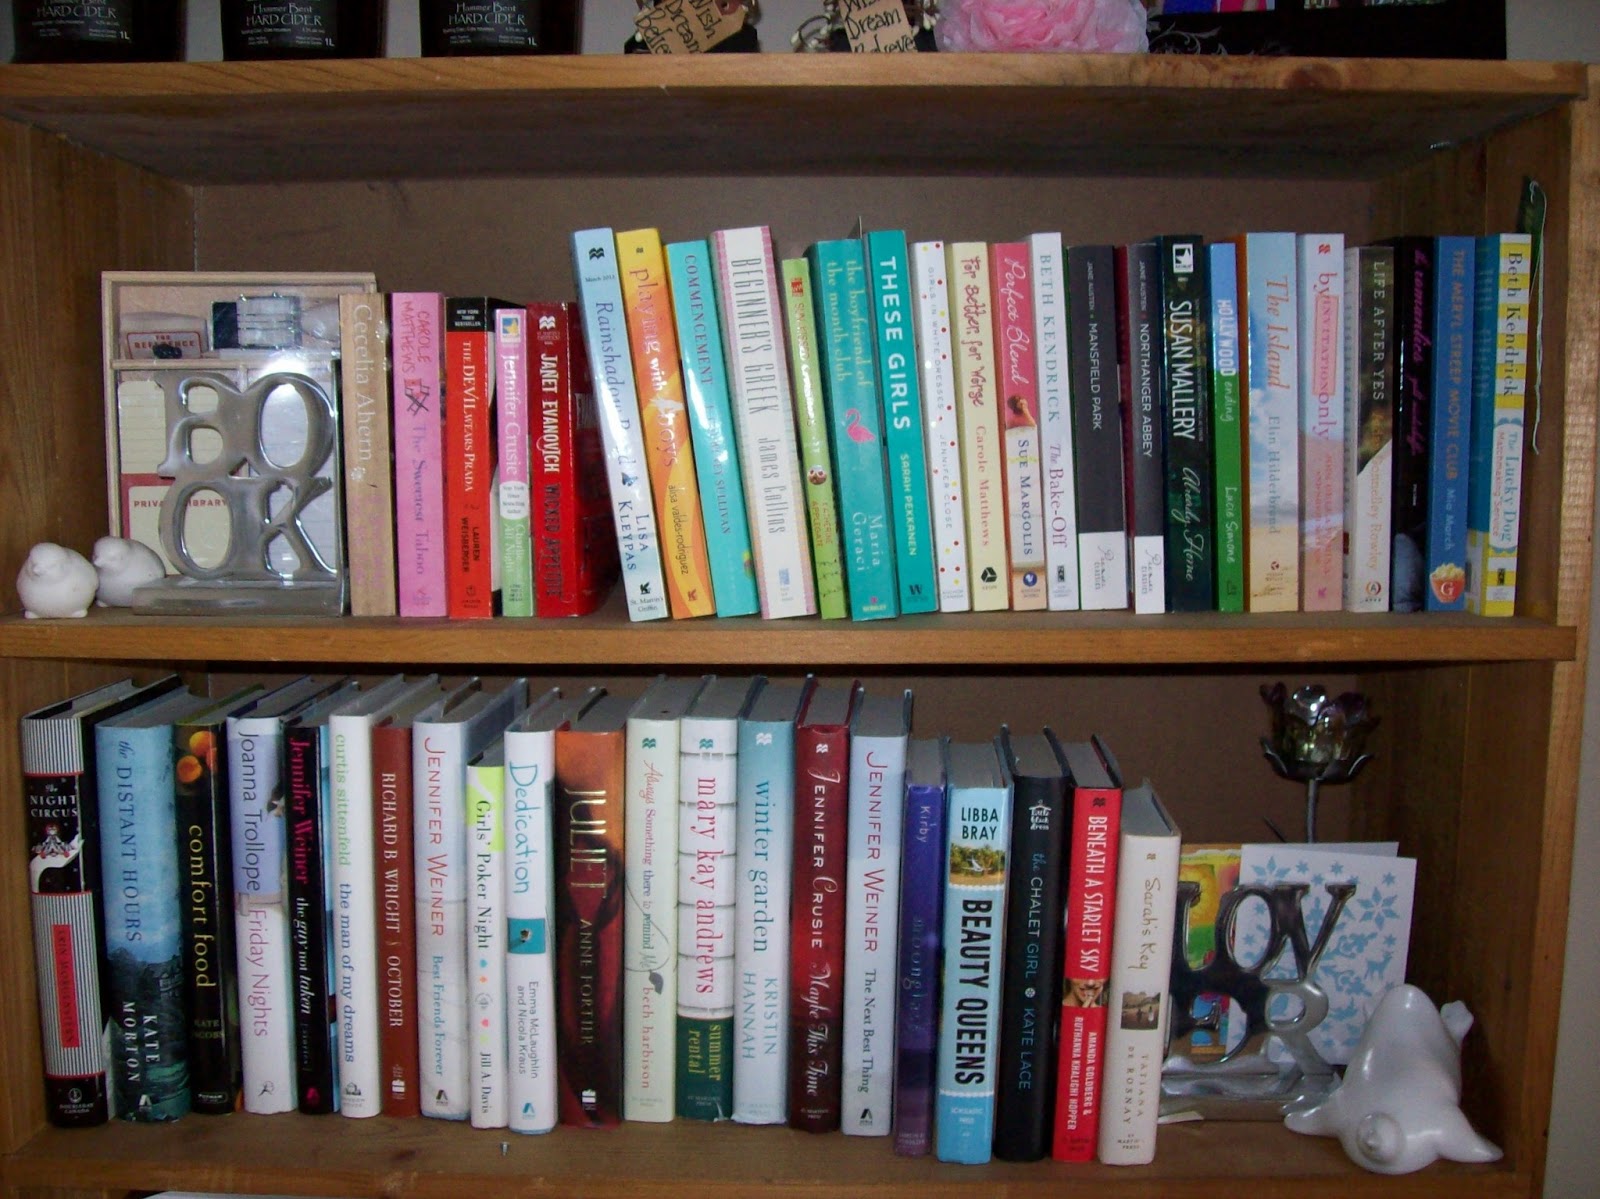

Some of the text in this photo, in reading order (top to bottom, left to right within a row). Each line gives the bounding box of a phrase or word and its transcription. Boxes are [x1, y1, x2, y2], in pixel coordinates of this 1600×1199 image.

[246, 13, 321, 26] HARD CIDER
[449, 12, 525, 26] HARD CIDER
[528, 37, 537, 46] 1L
[844, 8, 902, 39] Dream
[462, 341, 472, 361] THE
[684, 255, 713, 385] COMMENCEMENT
[730, 257, 779, 415] BEGINNER'S GREEK
[880, 256, 911, 430] THESE GIRLS
[1040, 255, 1060, 423] BETH KENDRICK
[1089, 323, 1101, 394] MANSFIELD
[1216, 298, 1238, 423] HOLLYWOOD ending
[1372, 261, 1386, 401] LIFE AFTER YES
[1445, 250, 1466, 480] THE MERYL STREEP MOVIE CLUB
[1502, 252, 1523, 397] Beth Kendrick
[352, 304, 375, 460] Cecelia Ahern
[463, 365, 479, 414] DEVIL
[500, 354, 520, 475] Jennifer Crusie
[934, 360, 945, 409] DRESSES
[1091, 397, 1102, 430] PARK
[1169, 300, 1195, 440] SUSAN MALLERY
[463, 453, 476, 491] PRADA
[464, 414, 473, 451] WEARS
[900, 454, 918, 556] SARAH PEKKANEN
[975, 425, 993, 547] Carole Matthews
[1018, 440, 1033, 556] SUE MARGOLIS
[1049, 444, 1068, 548] The Bake-Off
[460, 517, 471, 573] WEISBERGER
[472, 527, 481, 561] LAUREN
[618, 500, 637, 571] KLEYPAS
[634, 513, 650, 553] LISA
[868, 513, 883, 567] Maria
[30, 795, 77, 805] NIGHT
[31, 809, 78, 818] CIRCUS
[239, 732, 267, 891] Joanna Trollope
[424, 737, 448, 936] JENNIFER WEINER
[509, 762, 539, 894] Dedication
[564, 788, 608, 898] JULIET
[916, 805, 931, 843] Kirby
[961, 807, 999, 822] LIBBA
[962, 825, 997, 840] BRAY
[380, 772, 401, 933] RICHARD B. WRIGHT
[475, 800, 493, 949] Girls' Poker Night
[690, 777, 724, 994] mary kay andrews
[748, 781, 775, 953] winter garden
[807, 768, 841, 948] JENNIFER CRUSIE
[862, 752, 889, 952] JENNIFER WEINER
[1080, 816, 1107, 972] BENEATH A STARLET SKY
[189, 825, 215, 987] comfort food
[958, 899, 993, 988] BEAUTY
[1026, 853, 1046, 978] the CHALET GIRL
[1128, 877, 1161, 970] Sarah's Key
[245, 909, 271, 1037] Friday Nights
[339, 883, 357, 1063] the man of my dreams
[386, 955, 404, 1027] OCTOBER
[431, 955, 446, 1076] Best Friends Forever
[741, 972, 758, 1060] HANNAH
[764, 977, 777, 1056] KRISTIN
[123, 1001, 141, 1082] MORTON
[143, 1015, 160, 1063] KATE
[517, 985, 528, 1074] and Nicola Kraus
[529, 980, 540, 1079] Emma McLaughlin
[641, 987, 655, 1089] beth harbison
[688, 1030, 703, 1074] rental
[708, 1024, 723, 1080] summer
[857, 969, 876, 1093] The Next Best Thing
[955, 997, 989, 1085] QUEENS
[1019, 1008, 1035, 1089] KATE LACE
[1072, 1016, 1084, 1058] RUTHANNA
[1067, 1098, 1079, 1130] HOPPER
[1069, 1059, 1082, 1096] KHALIGHI
